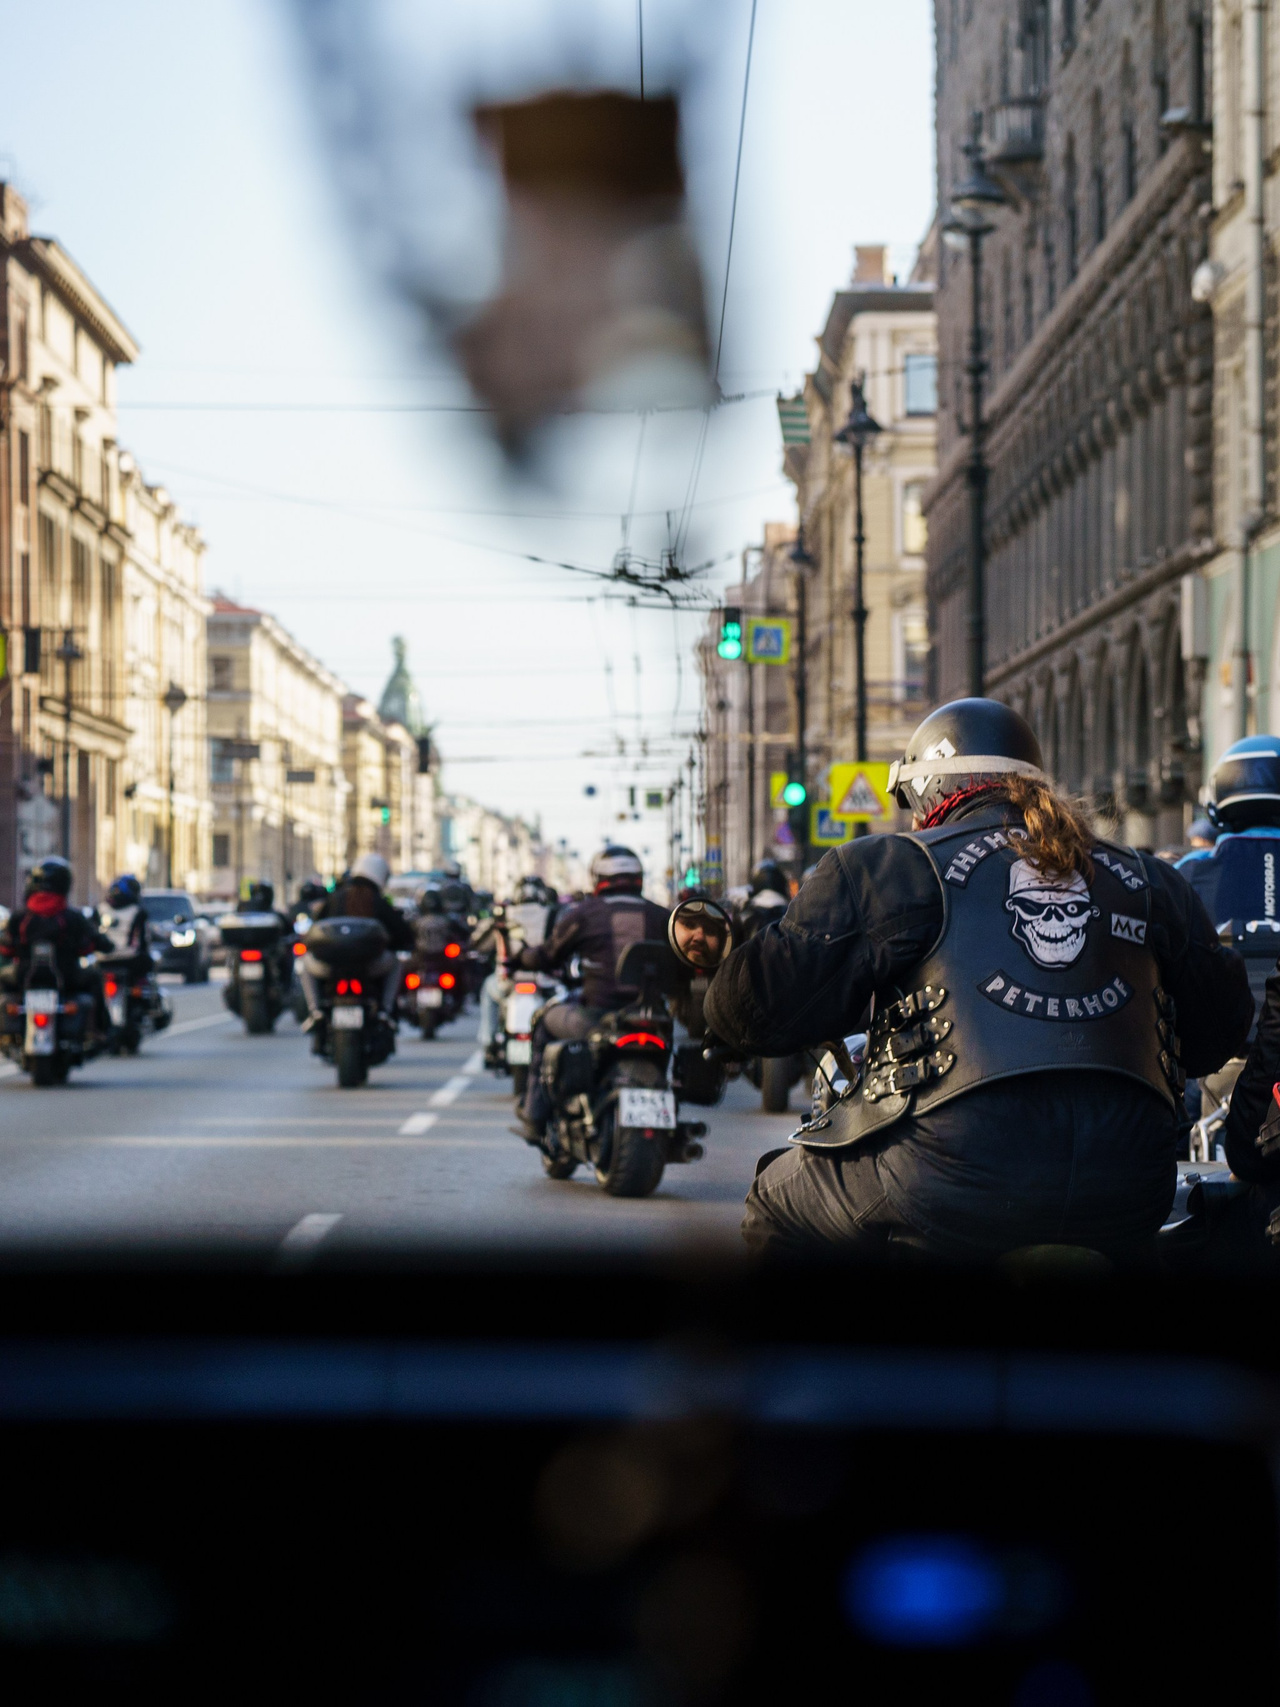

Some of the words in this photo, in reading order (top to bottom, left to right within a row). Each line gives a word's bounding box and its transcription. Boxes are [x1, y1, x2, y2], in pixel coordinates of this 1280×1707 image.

[944, 843, 987, 881] THE
[1264, 853, 1275, 916] MOTORRAD
[1113, 917, 1144, 940] MC
[985, 975, 1128, 1018] PETERHOF
